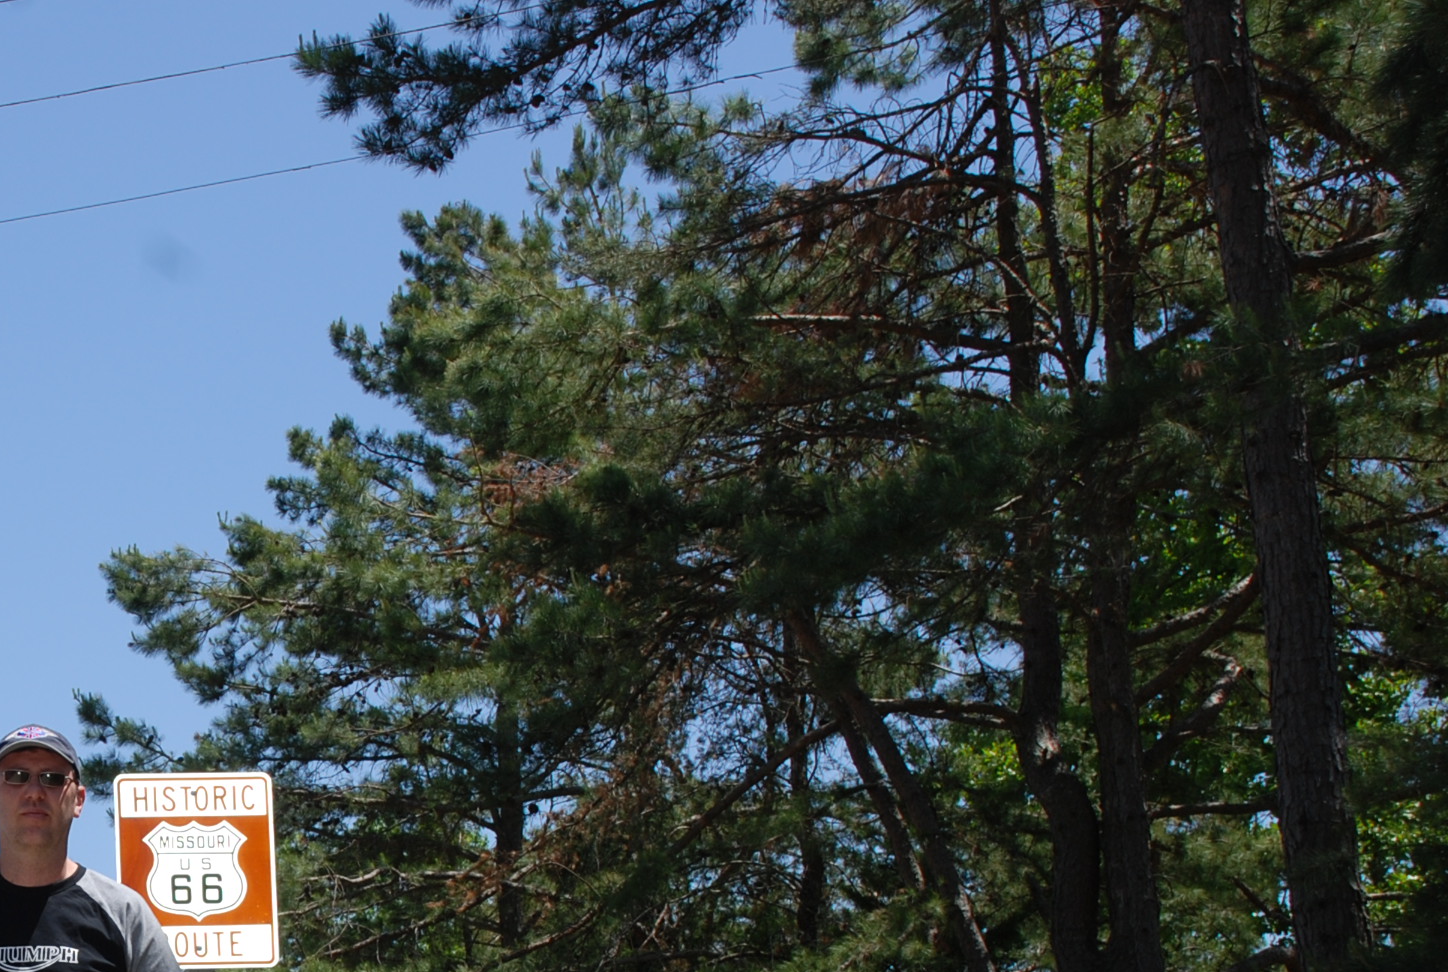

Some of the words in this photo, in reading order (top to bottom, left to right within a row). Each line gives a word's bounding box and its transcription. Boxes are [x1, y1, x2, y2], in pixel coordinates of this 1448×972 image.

[133, 785, 255, 812] HISTORIC
[159, 835, 231, 849] MISSOURI
[171, 873, 223, 904] 66
[174, 931, 243, 957] OUTE
